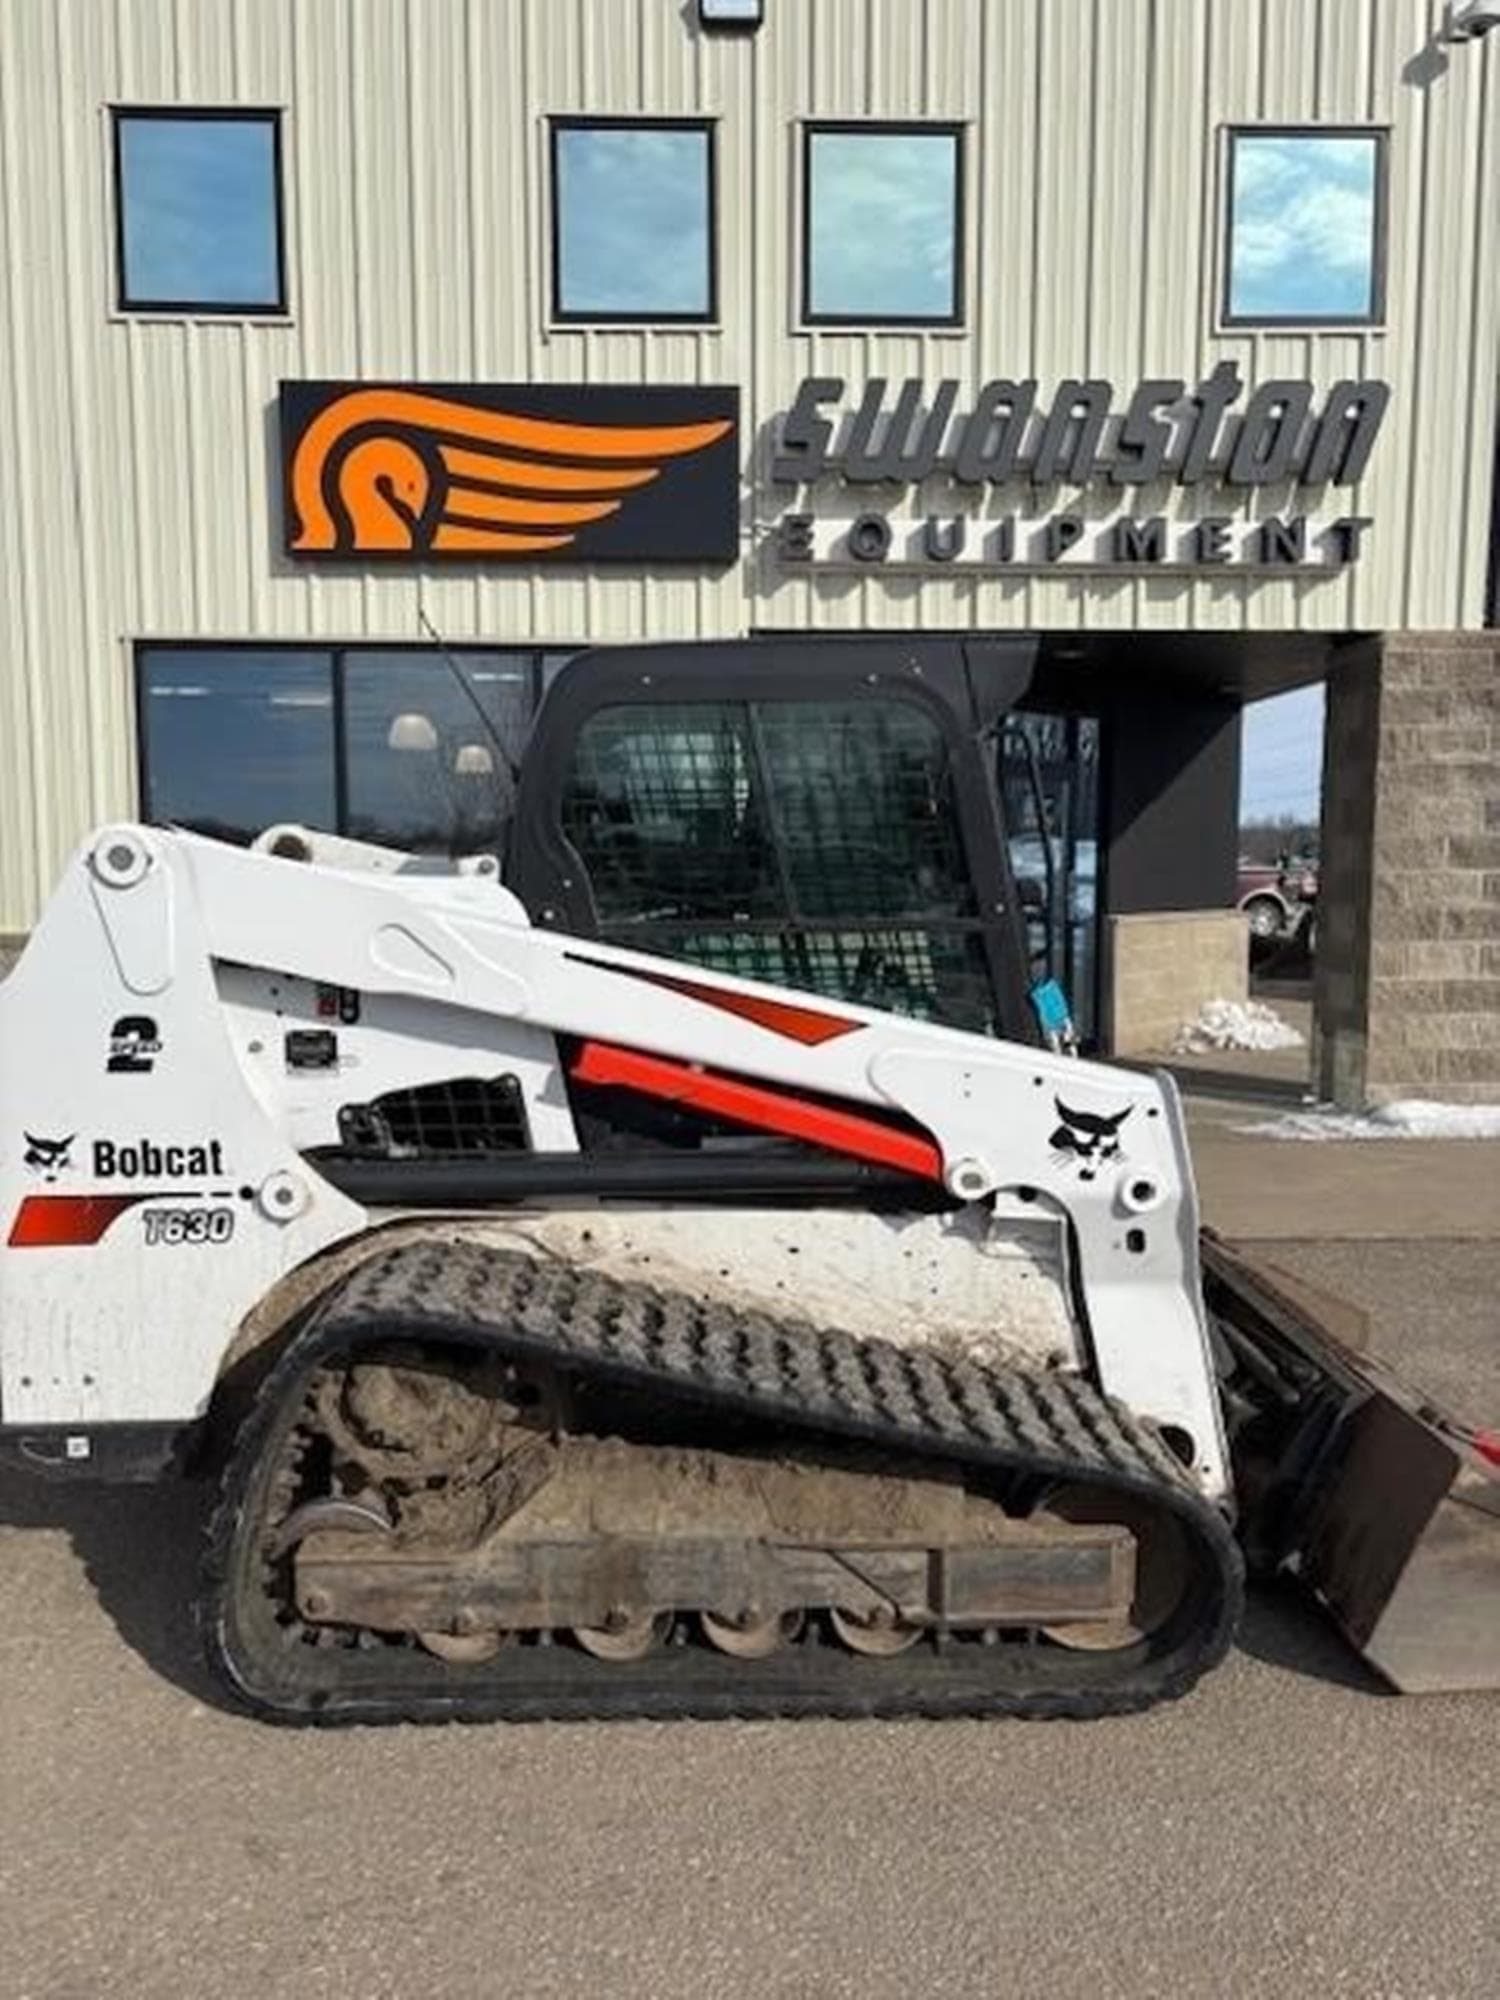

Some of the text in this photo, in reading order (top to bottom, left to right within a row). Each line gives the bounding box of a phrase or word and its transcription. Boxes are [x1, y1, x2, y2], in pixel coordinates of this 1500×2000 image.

[778, 514, 1373, 564] EQUIPMENT
[106, 1016, 157, 1073] 2
[93, 1140, 223, 1178] Bobcat
[142, 1208, 234, 1245] T630
